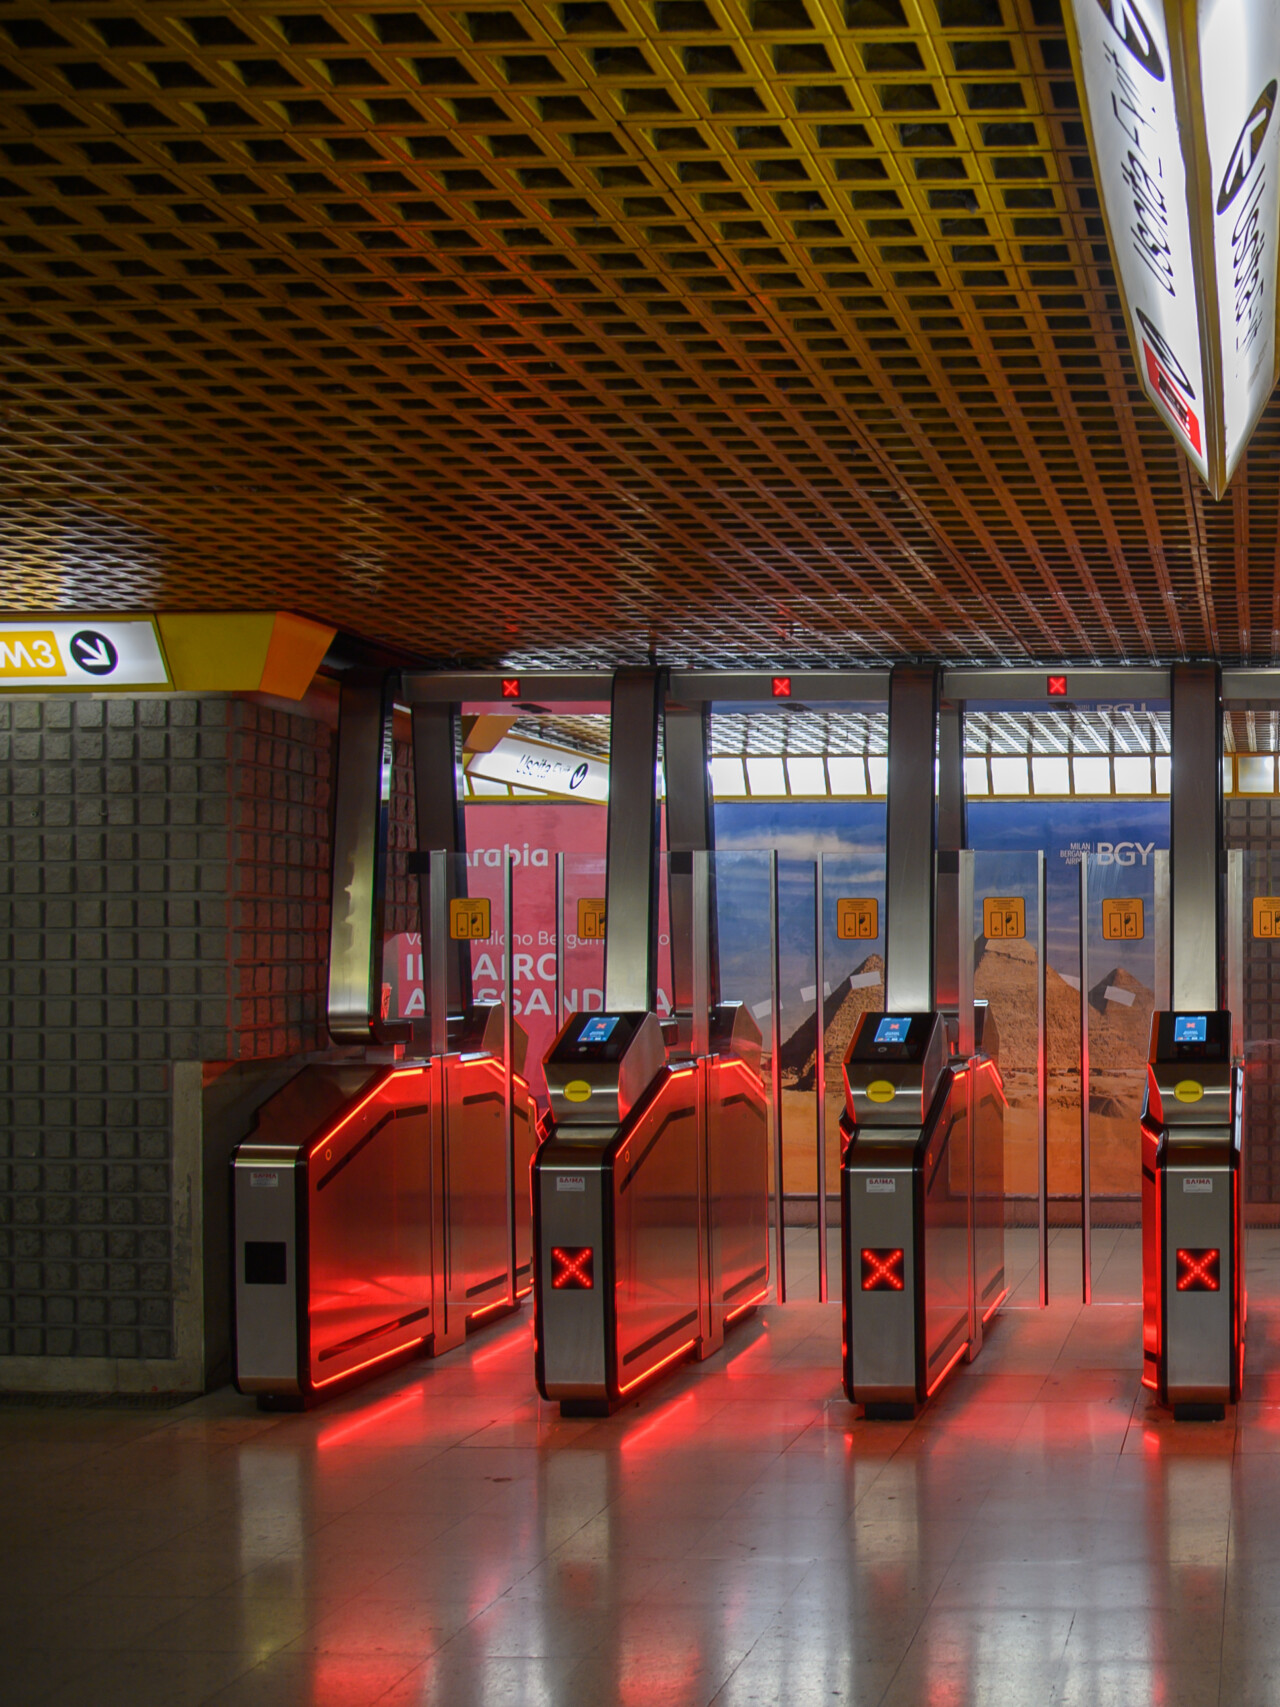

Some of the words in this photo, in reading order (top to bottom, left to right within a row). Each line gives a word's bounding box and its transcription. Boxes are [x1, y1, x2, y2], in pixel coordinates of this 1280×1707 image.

[1121, 148, 1176, 297] Uscita
[1232, 163, 1266, 321] Uscita
[0, 640, 56, 668] M3
[466, 843, 548, 867] rabia
[1070, 842, 1090, 850] MILAN
[1097, 842, 1155, 866] BGY
